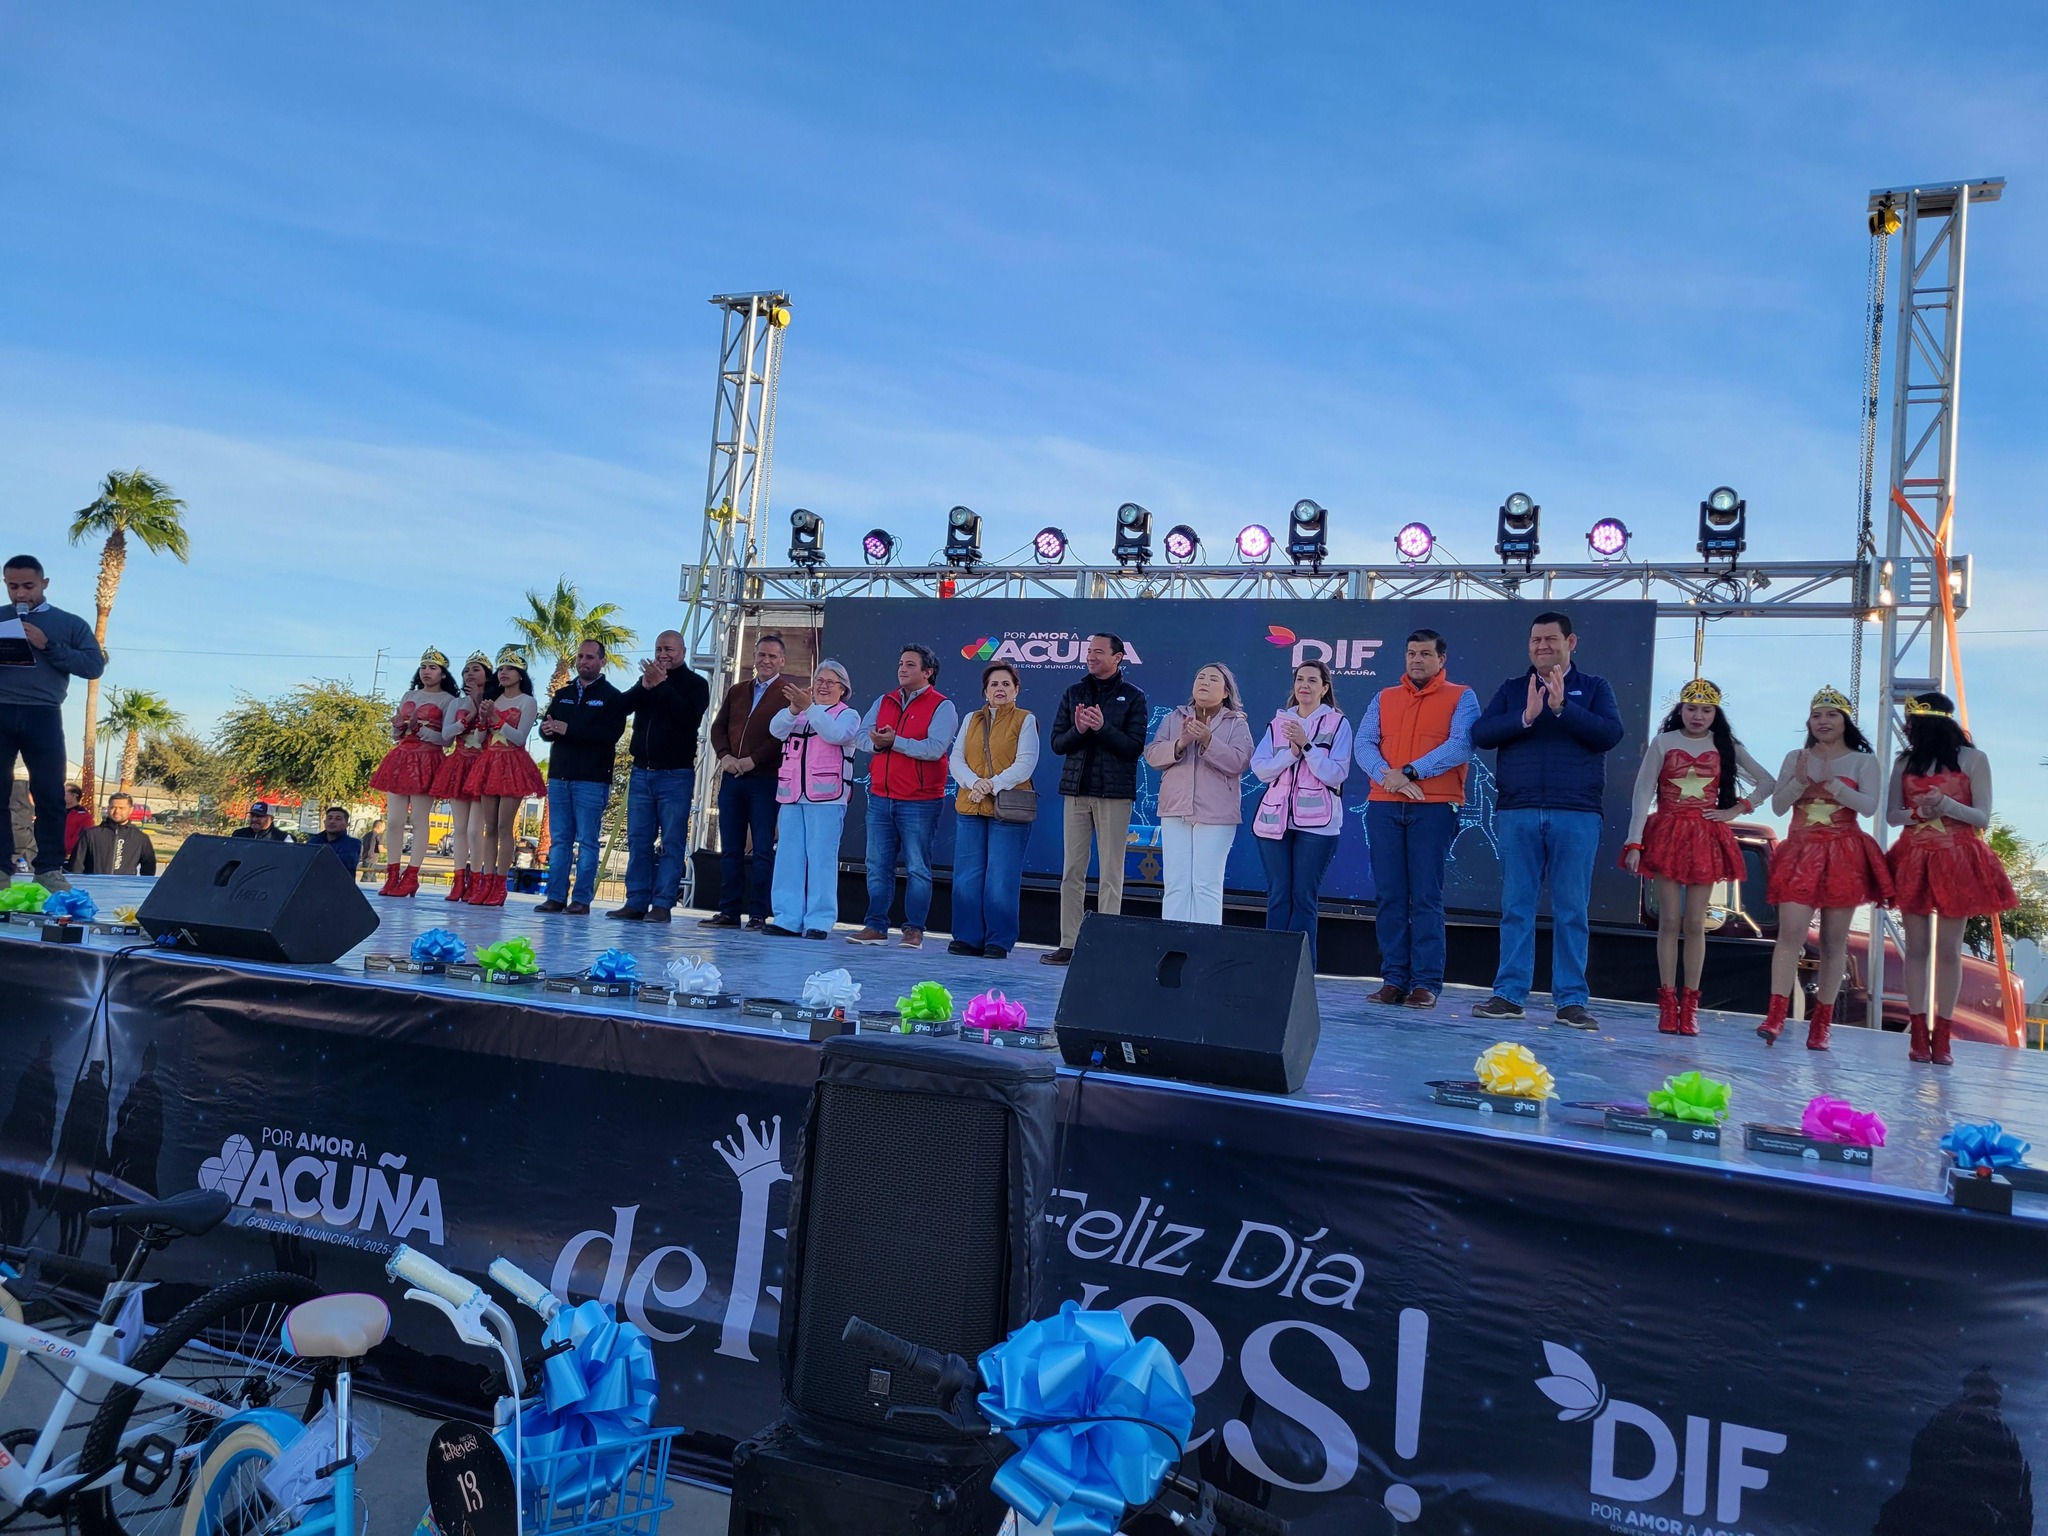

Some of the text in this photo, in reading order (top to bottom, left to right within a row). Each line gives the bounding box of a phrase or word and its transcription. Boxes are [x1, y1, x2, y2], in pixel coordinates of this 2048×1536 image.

[1003, 632, 1026, 640] POR
[1028, 632, 1069, 640] AMOR
[991, 634, 1143, 665] ACUA
[1292, 639, 1383, 669] DIF
[592, 985, 606, 993] ghia
[690, 997, 705, 1005] ghia
[796, 1010, 812, 1018] ghia
[914, 1024, 931, 1033] ghia
[1019, 1036, 1036, 1045] ghia
[1514, 1101, 1536, 1112] ghia
[262, 1127, 368, 1160] POR AMOR A
[1692, 1128, 1716, 1140] ghia
[1842, 1148, 1868, 1160] ghia
[237, 1149, 445, 1246] ACUÑA
[246, 1216, 302, 1237] GOBIERNO
[303, 1227, 360, 1250] MUNICIPAL
[1212, 1219, 1365, 1311] Día
[1590, 1398, 1788, 1525] DIF
[456, 1470, 484, 1513] 13
[1591, 1502, 1622, 1522] POR
[1625, 1510, 1684, 1536] AMOR
